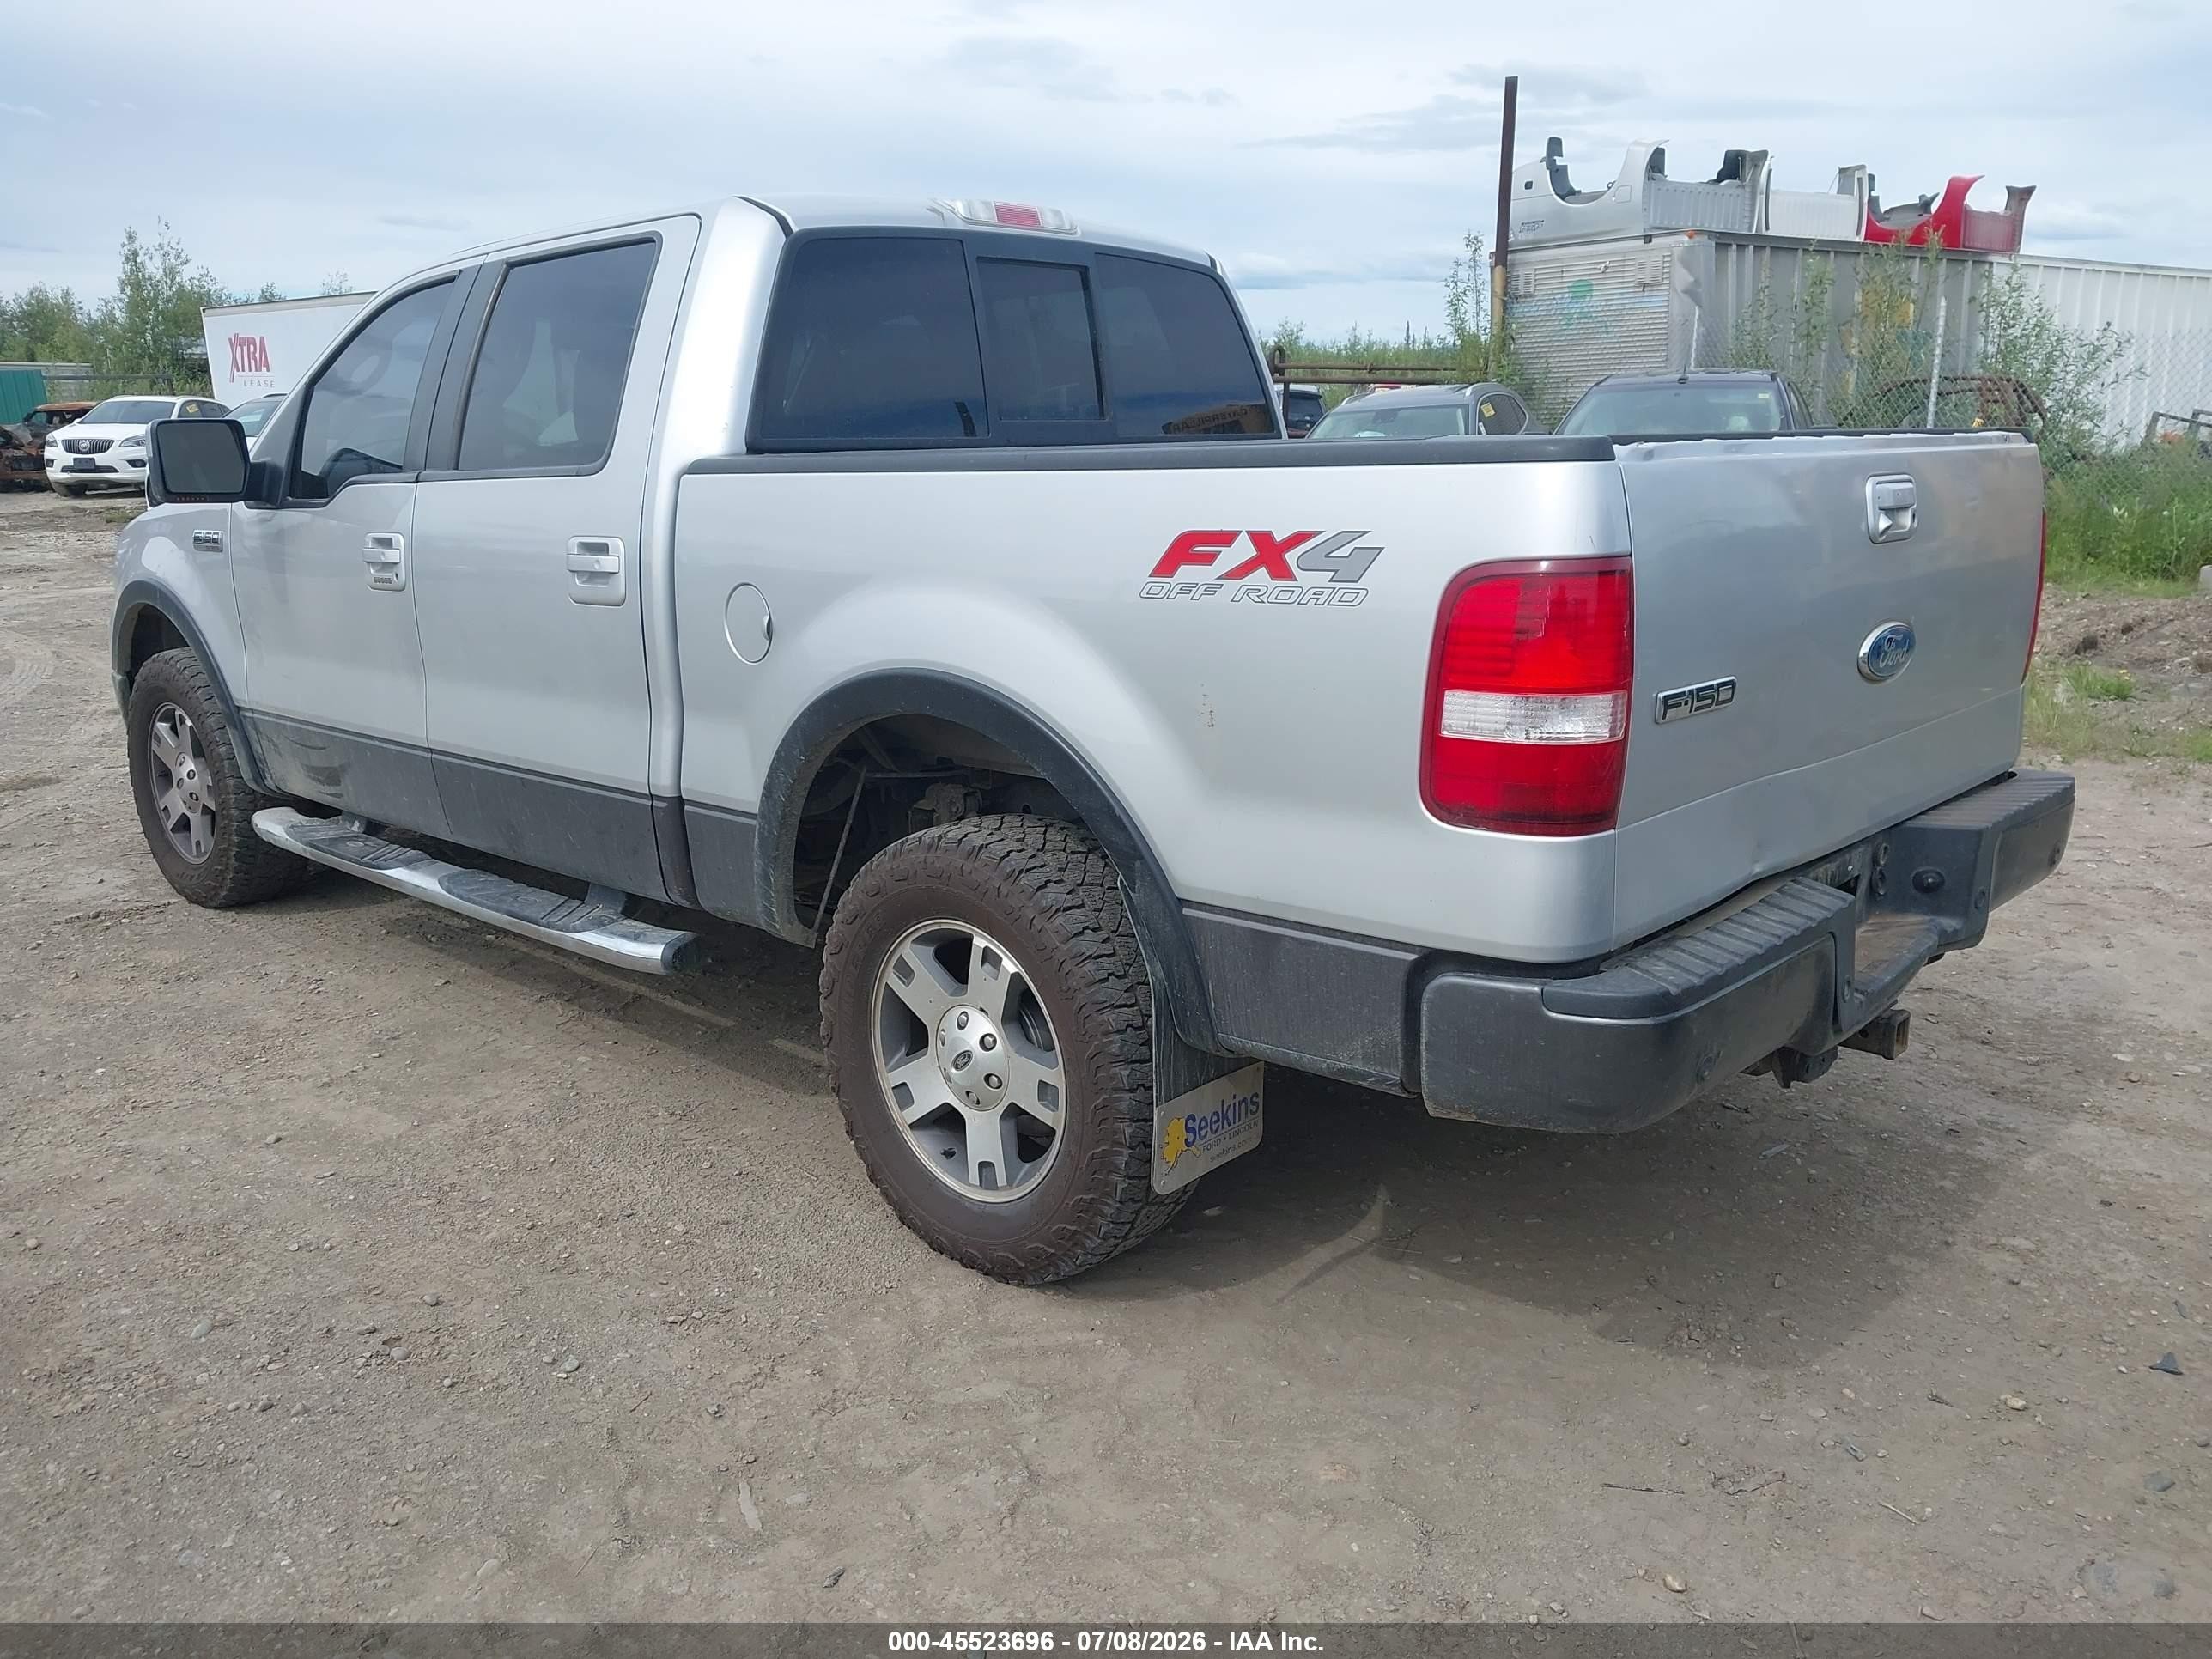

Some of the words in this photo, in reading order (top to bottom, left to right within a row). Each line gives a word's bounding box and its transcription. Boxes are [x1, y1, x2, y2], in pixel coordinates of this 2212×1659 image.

[228, 332, 270, 383] XTRA
[243, 380, 276, 389] LEASE
[1148, 530, 1385, 583] FX4
[1139, 581, 1224, 600] OFF
[1230, 584, 1369, 607] ROAD
[1879, 634, 1911, 668] Ford
[1662, 678, 1736, 720] F-150
[1184, 1091, 1260, 1148] Seekins
[1202, 1138, 1223, 1152] FORD
[1228, 1119, 1259, 1140] LINCOLN
[1210, 1136, 1255, 1163] skins.co
